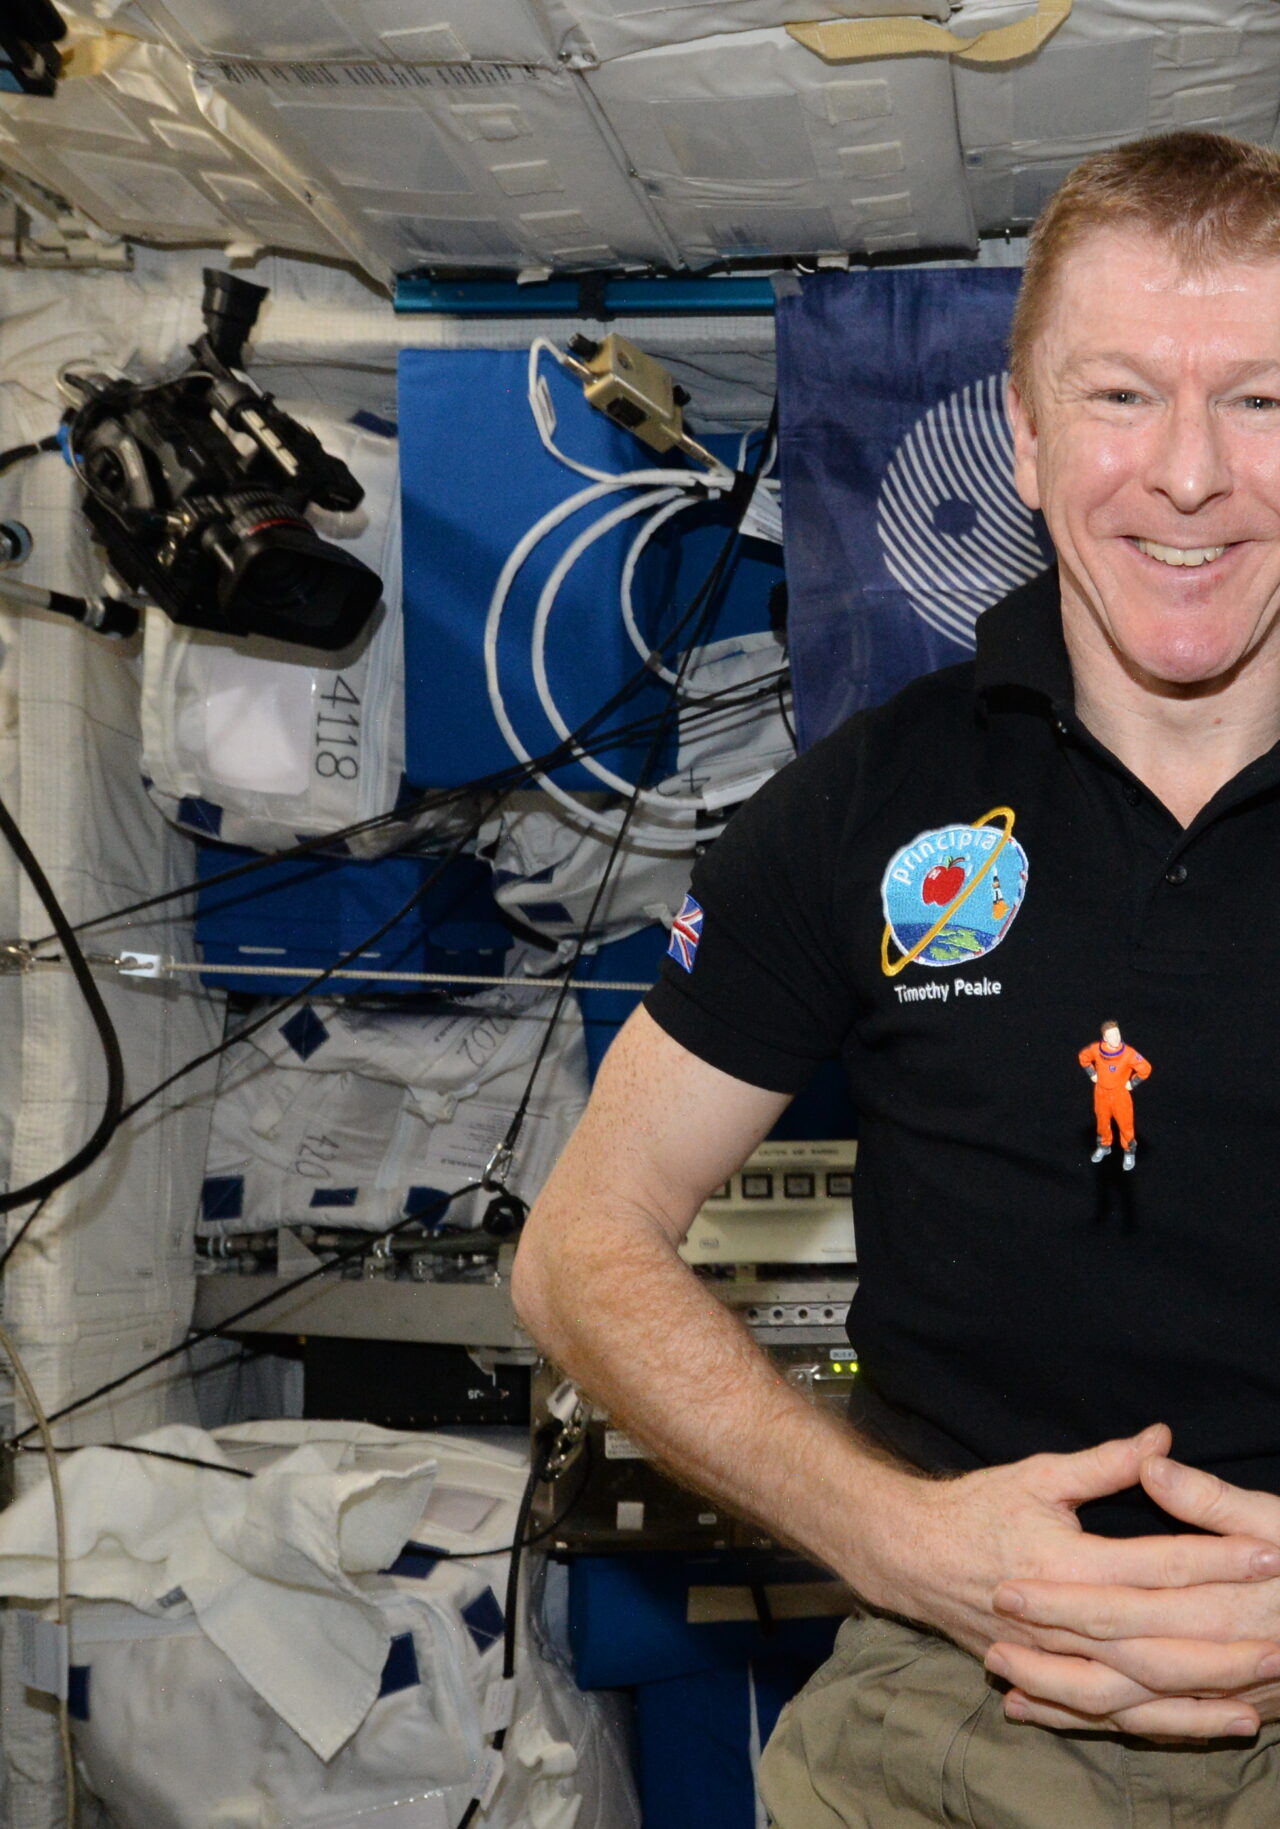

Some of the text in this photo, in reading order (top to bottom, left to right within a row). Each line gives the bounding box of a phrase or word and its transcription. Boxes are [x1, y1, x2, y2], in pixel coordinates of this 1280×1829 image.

[316, 675, 360, 780] 4118
[893, 831, 997, 885] principia
[894, 976, 1002, 1003] Timothy Peake
